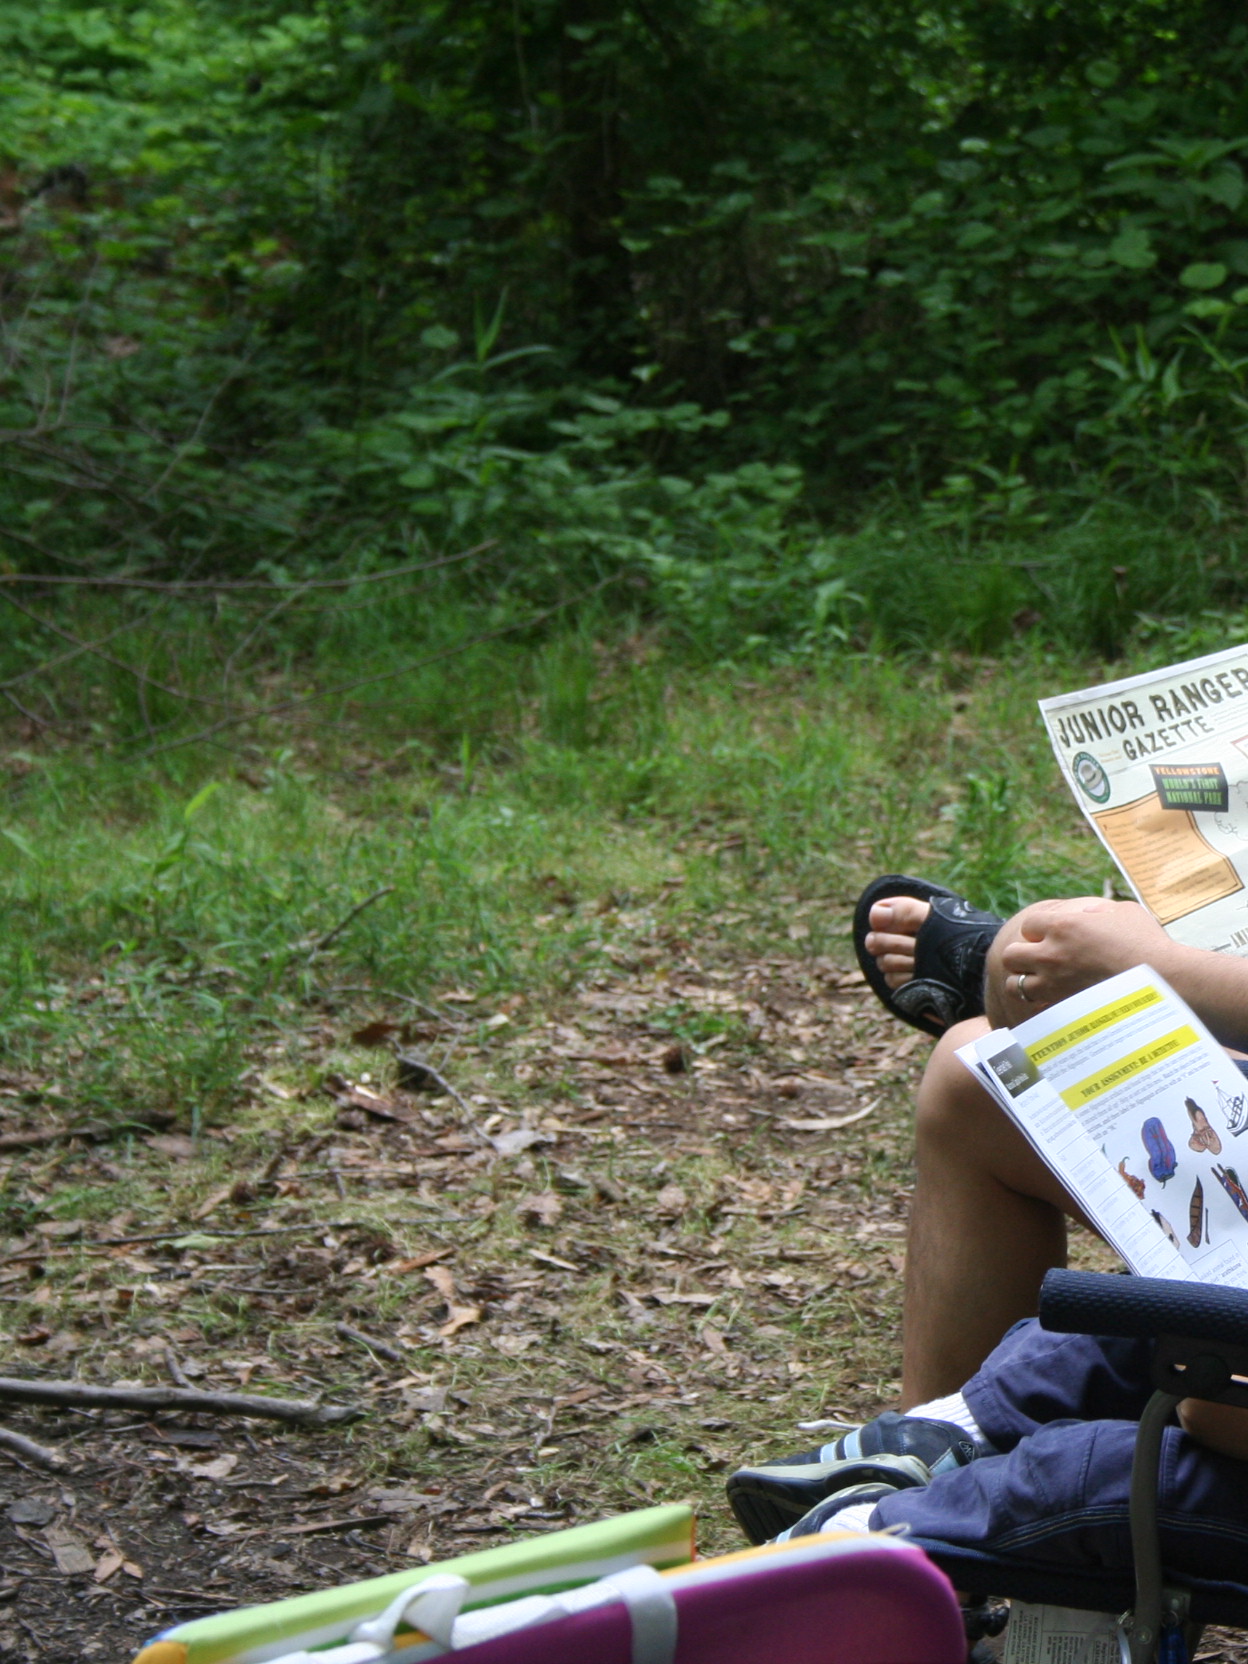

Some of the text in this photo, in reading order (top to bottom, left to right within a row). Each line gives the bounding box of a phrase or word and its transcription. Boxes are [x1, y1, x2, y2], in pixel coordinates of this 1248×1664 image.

[1058, 700, 1143, 748] JUNIOR
[1122, 715, 1214, 761] GAZETTE
[1154, 766, 1220, 776] YELLOWSTONE
[1166, 791, 1222, 806] NATIONAL PARK
[1031, 1039, 1068, 1062] TTENTION
